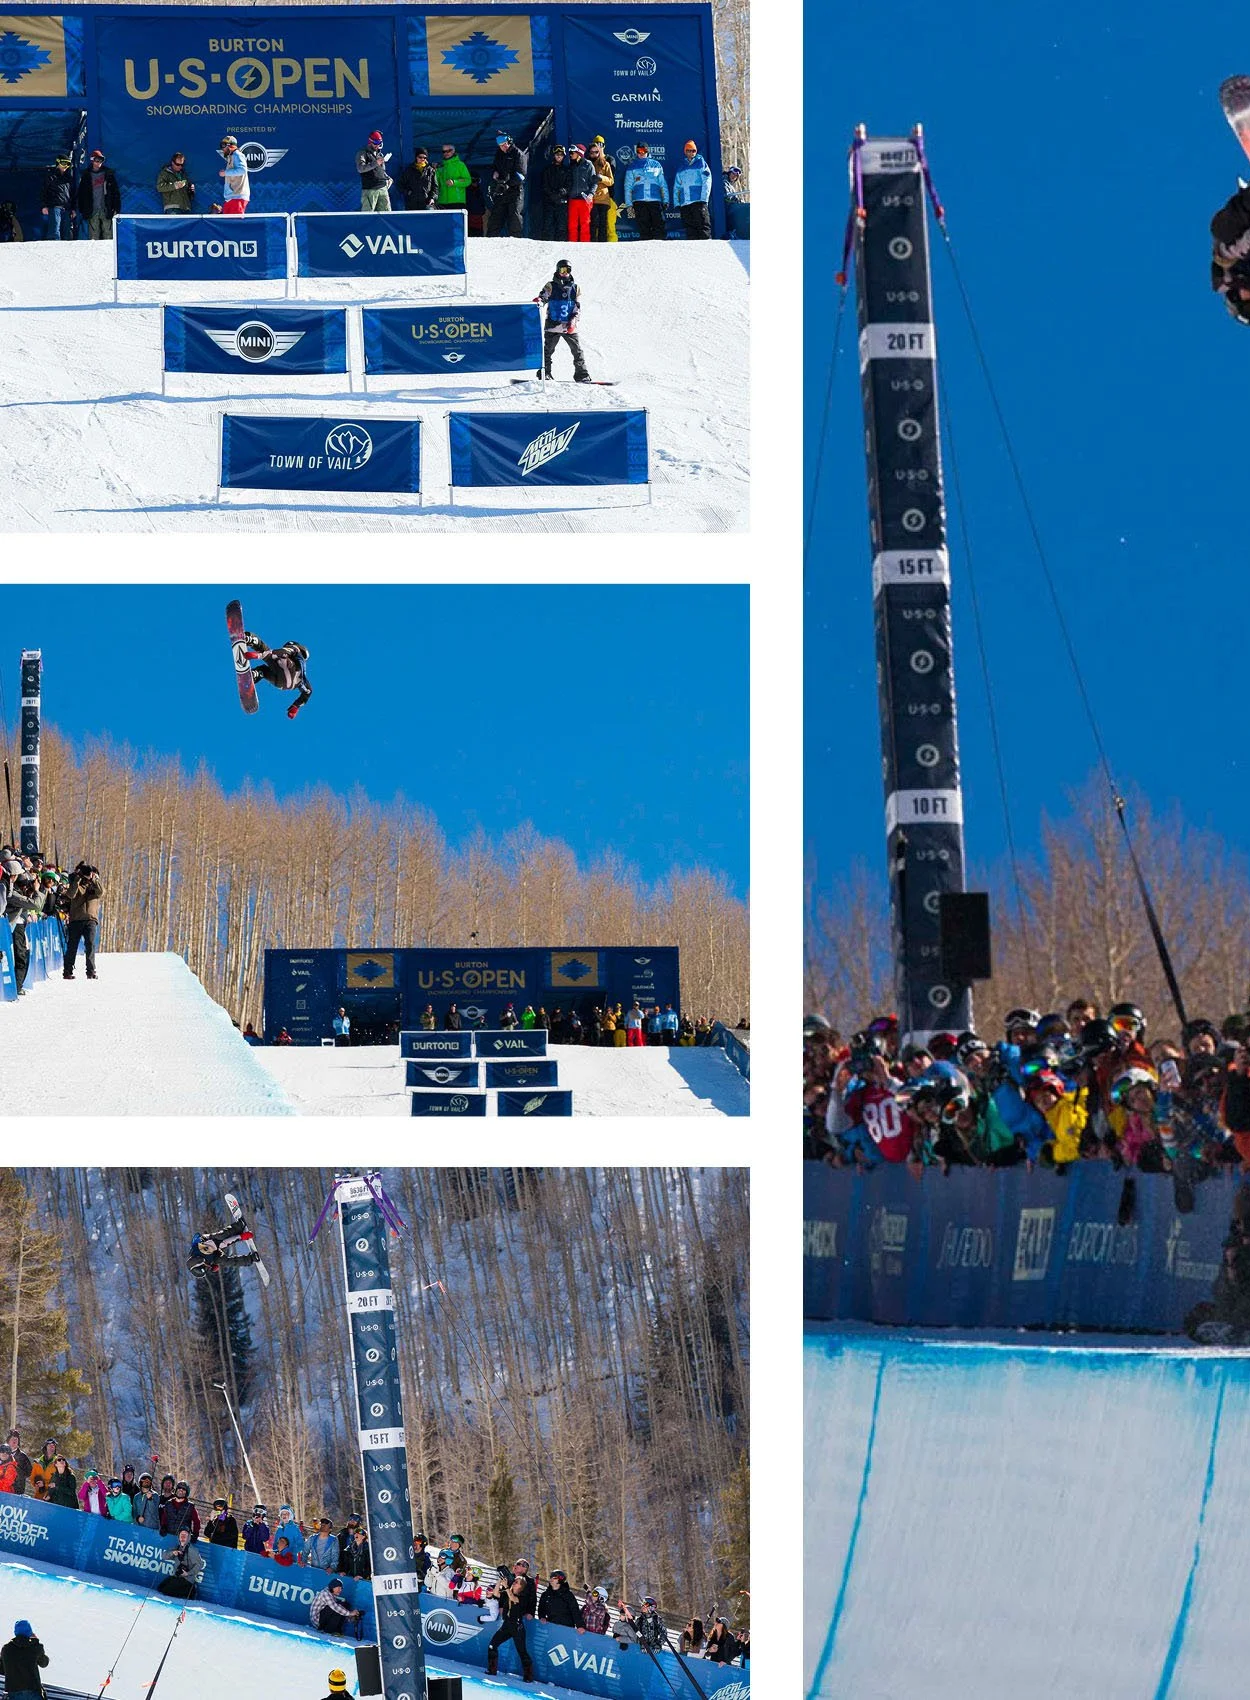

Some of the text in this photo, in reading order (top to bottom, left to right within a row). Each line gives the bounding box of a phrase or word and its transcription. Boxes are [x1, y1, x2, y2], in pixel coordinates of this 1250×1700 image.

[209, 38, 284, 52] BURTON
[611, 93, 661, 102] GARMIN
[146, 103, 353, 116] SNOWBOARDING CHAMPIONSHIPS
[614, 119, 664, 129] Thinsulate
[245, 153, 264, 162] MINI
[146, 241, 239, 258] BURTON
[365, 235, 419, 255] VAIL
[560, 304, 569, 318] 3
[240, 336, 271, 348] MINI
[888, 333, 925, 350] 20 FT
[269, 454, 353, 471] TOWN OF VAIL
[898, 558, 934, 575] 15 FT
[912, 798, 947, 814] 10 FT
[412, 1042, 451, 1050] BURTON
[504, 1039, 527, 1048] VAIL
[863, 1099, 902, 1144] 80
[358, 1296, 378, 1307] 20 FT
[369, 1433, 389, 1444] 15 FT
[249, 1575, 318, 1605] BURTO
[383, 1579, 403, 1590] 10 FT
[427, 1621, 454, 1635] MINI
[572, 1649, 616, 1679] VAIL
